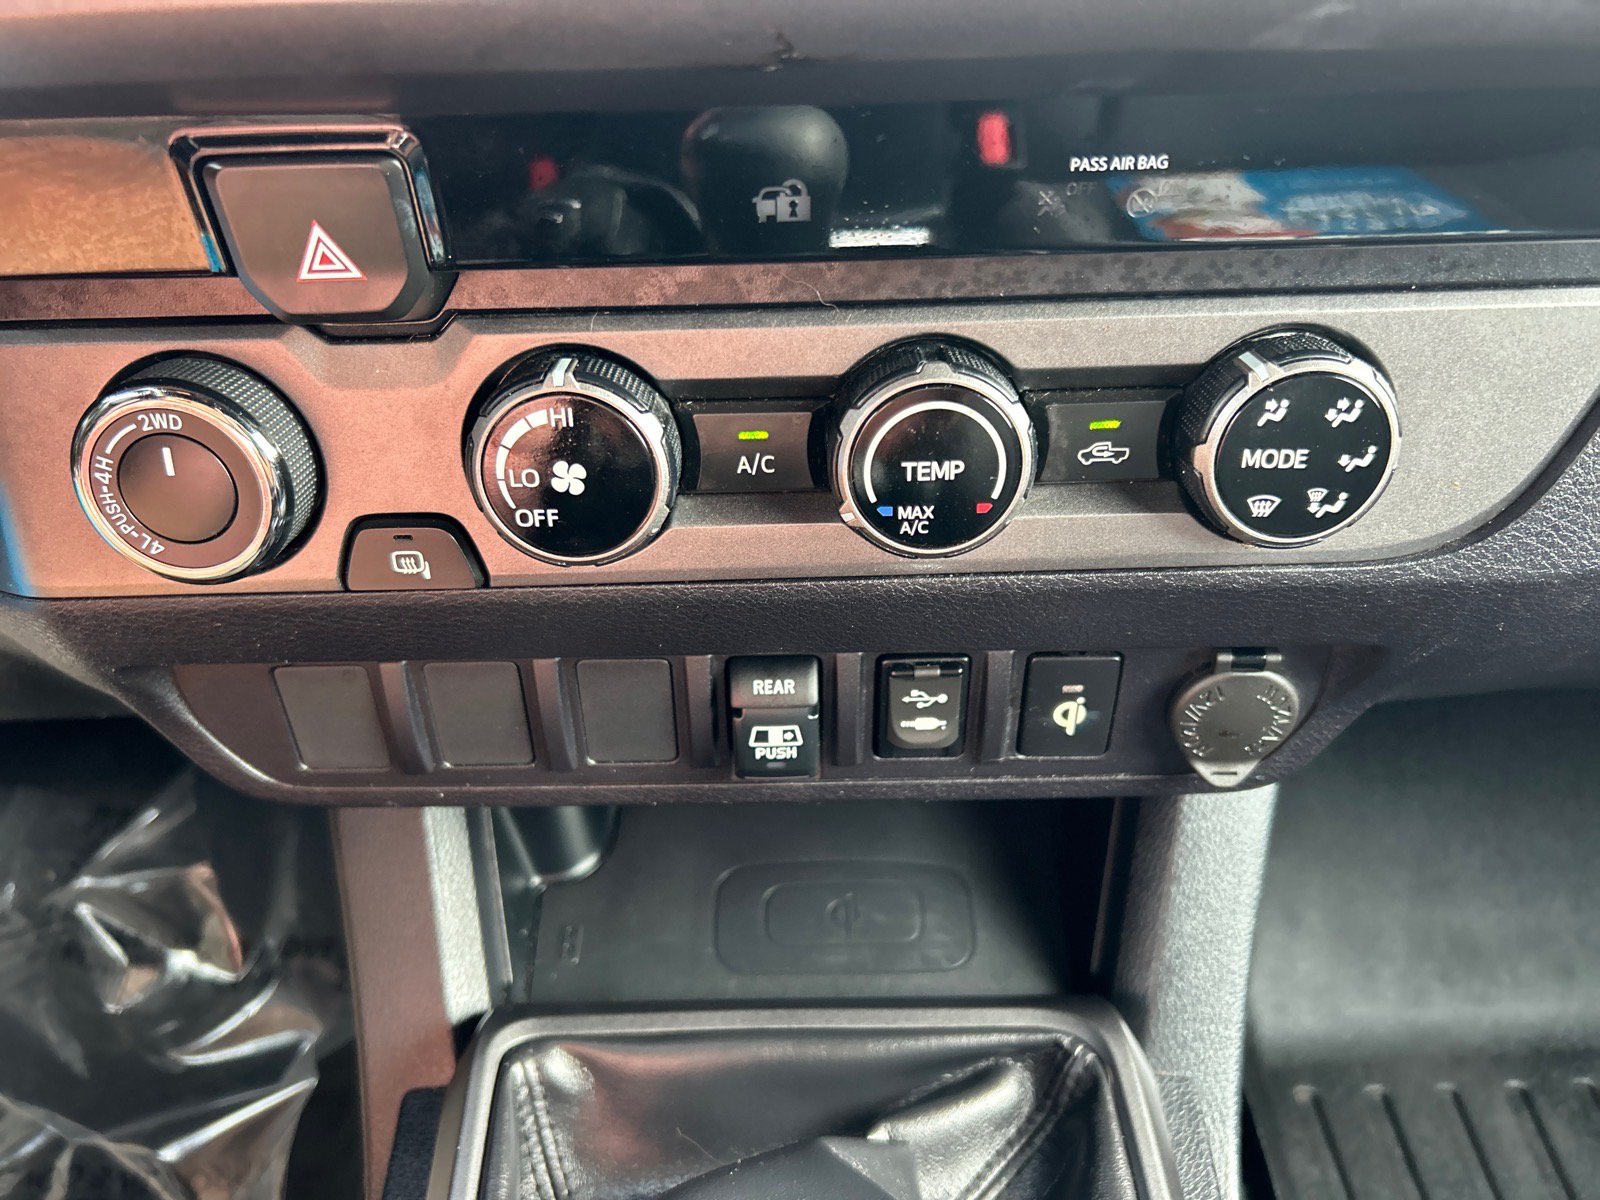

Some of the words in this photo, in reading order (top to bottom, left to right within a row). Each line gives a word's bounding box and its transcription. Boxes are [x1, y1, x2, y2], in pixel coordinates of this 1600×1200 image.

[1069, 156, 1108, 172] PASS
[1109, 155, 1135, 171] AIR
[1136, 154, 1169, 170] BAG
[1066, 181, 1098, 196] OFF
[137, 413, 183, 431] 2WD
[549, 407, 574, 428] HI
[736, 452, 775, 476] A/C
[1241, 448, 1310, 469] MODE
[508, 468, 541, 488] LO
[901, 460, 966, 482] TEMP
[515, 508, 560, 528] OFF
[897, 505, 935, 520] MAX
[899, 520, 930, 536] A/C
[752, 679, 796, 695] REAR
[755, 746, 798, 760] PUSH
